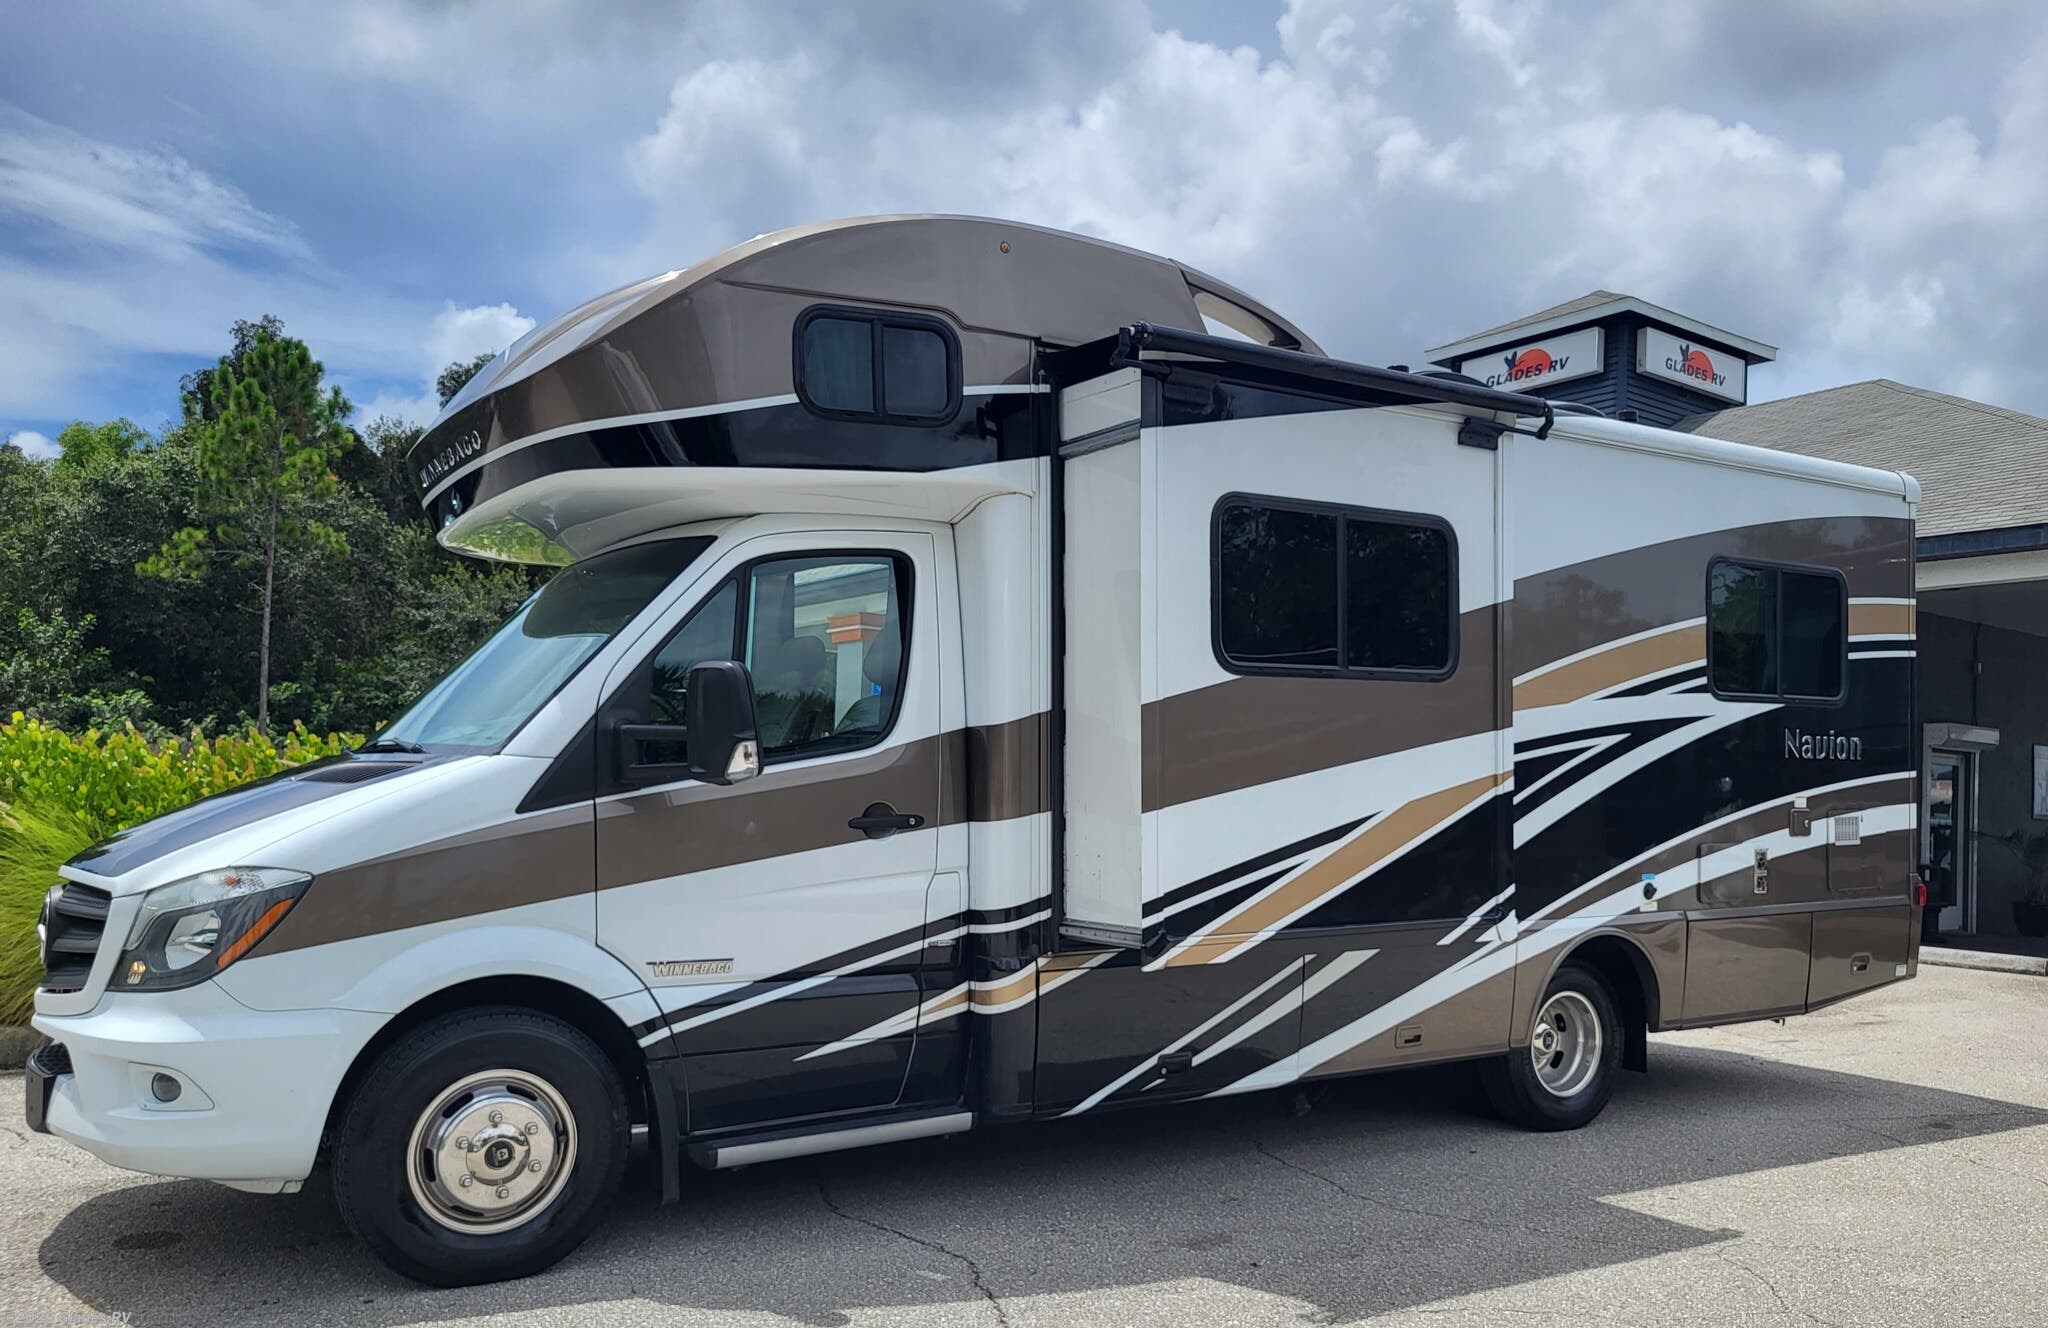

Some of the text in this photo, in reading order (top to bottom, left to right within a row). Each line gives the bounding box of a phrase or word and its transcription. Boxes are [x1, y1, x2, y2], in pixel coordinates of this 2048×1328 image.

[1486, 356, 1570, 388] GLADES RV
[1665, 357, 1726, 387] GLADES RV
[1784, 728, 1862, 760] Navion
[652, 961, 734, 977] WINNEBAGO
